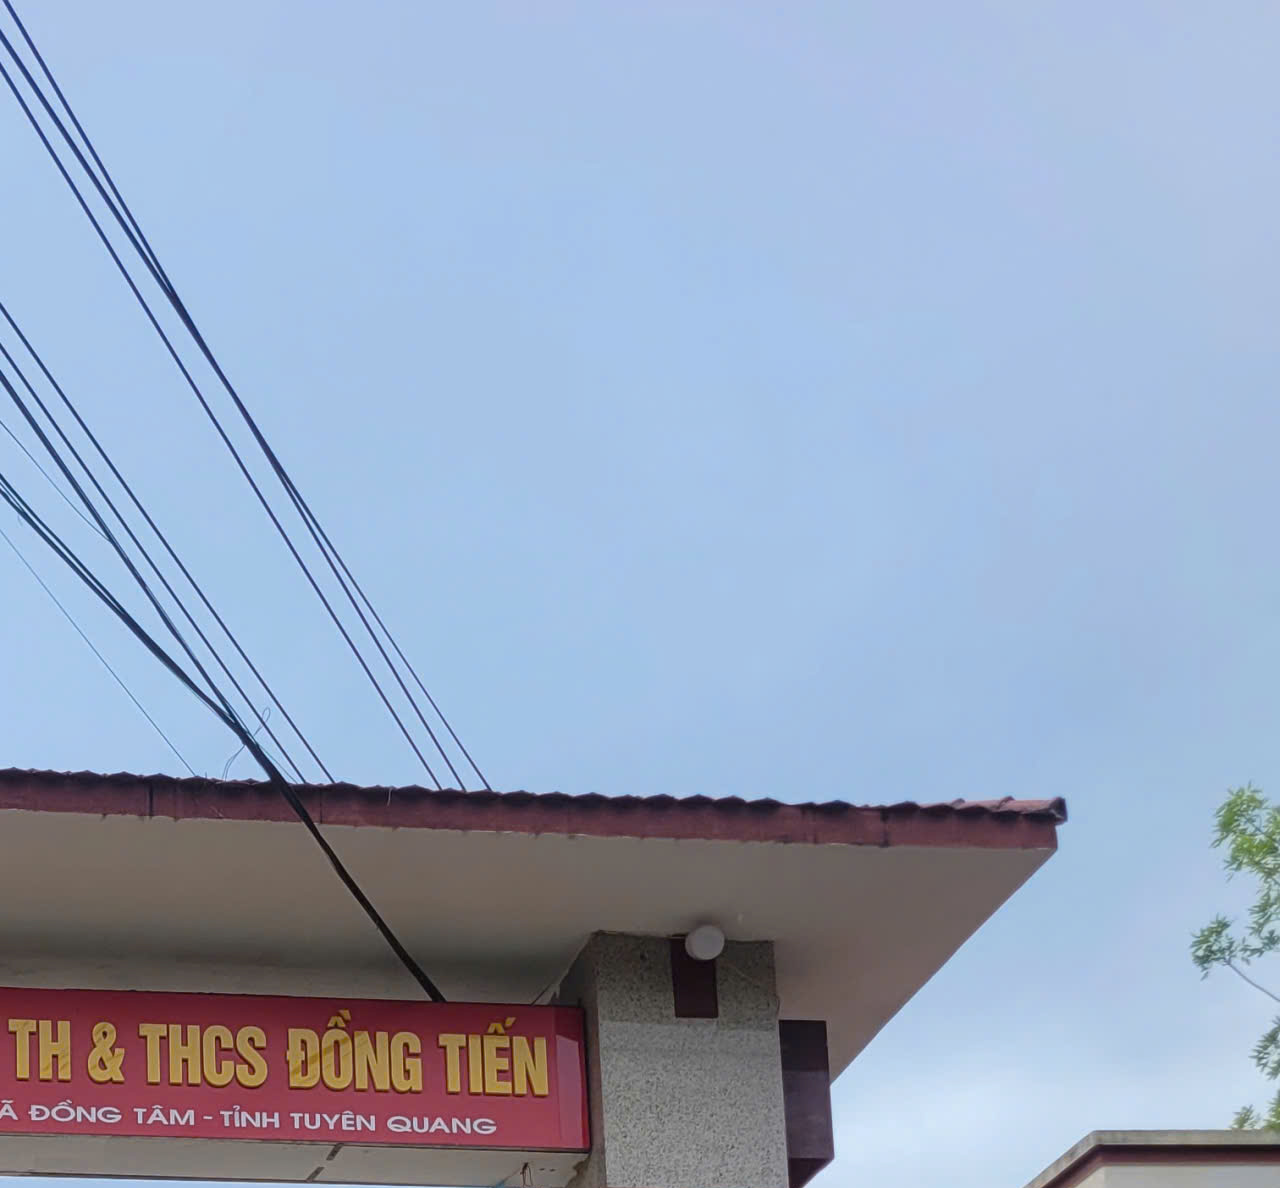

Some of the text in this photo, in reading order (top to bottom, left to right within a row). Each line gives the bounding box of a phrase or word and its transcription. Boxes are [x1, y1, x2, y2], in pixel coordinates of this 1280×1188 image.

[8, 1018, 72, 1082] TH
[87, 1022, 126, 1085] &
[139, 1023, 269, 1088] THCS
[287, 1009, 424, 1094] ĐỒNG
[438, 1016, 551, 1097] TIẾN
[28, 1099, 123, 1124] ĐỒNG
[133, 1105, 196, 1126] TÂM
[220, 1105, 281, 1129] TỈNH
[290, 1110, 377, 1132] TUYÊN
[387, 1115, 498, 1136] QUANG
